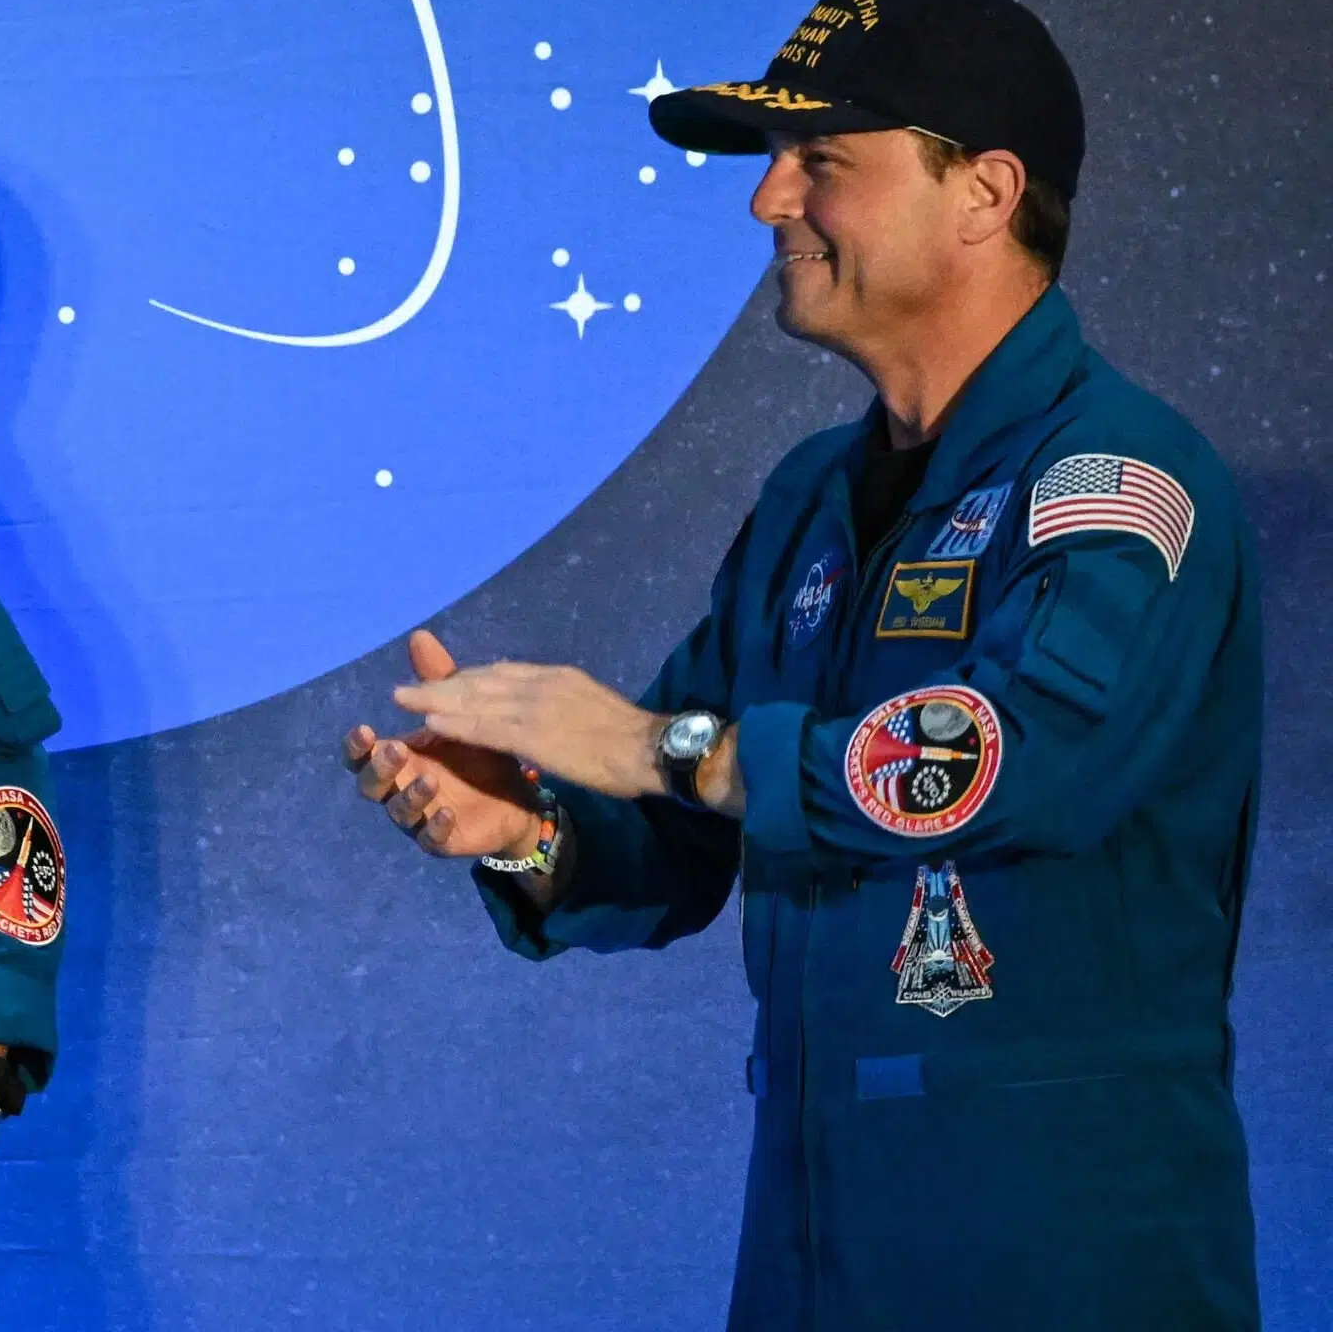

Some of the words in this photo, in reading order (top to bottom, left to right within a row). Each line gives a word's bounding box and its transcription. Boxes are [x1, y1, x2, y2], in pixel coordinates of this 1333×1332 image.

[806, 50, 822, 68] II
[793, 583, 832, 610] NASA
[974, 706, 997, 744] NASA
[483, 856, 533, 870] TOKYO
